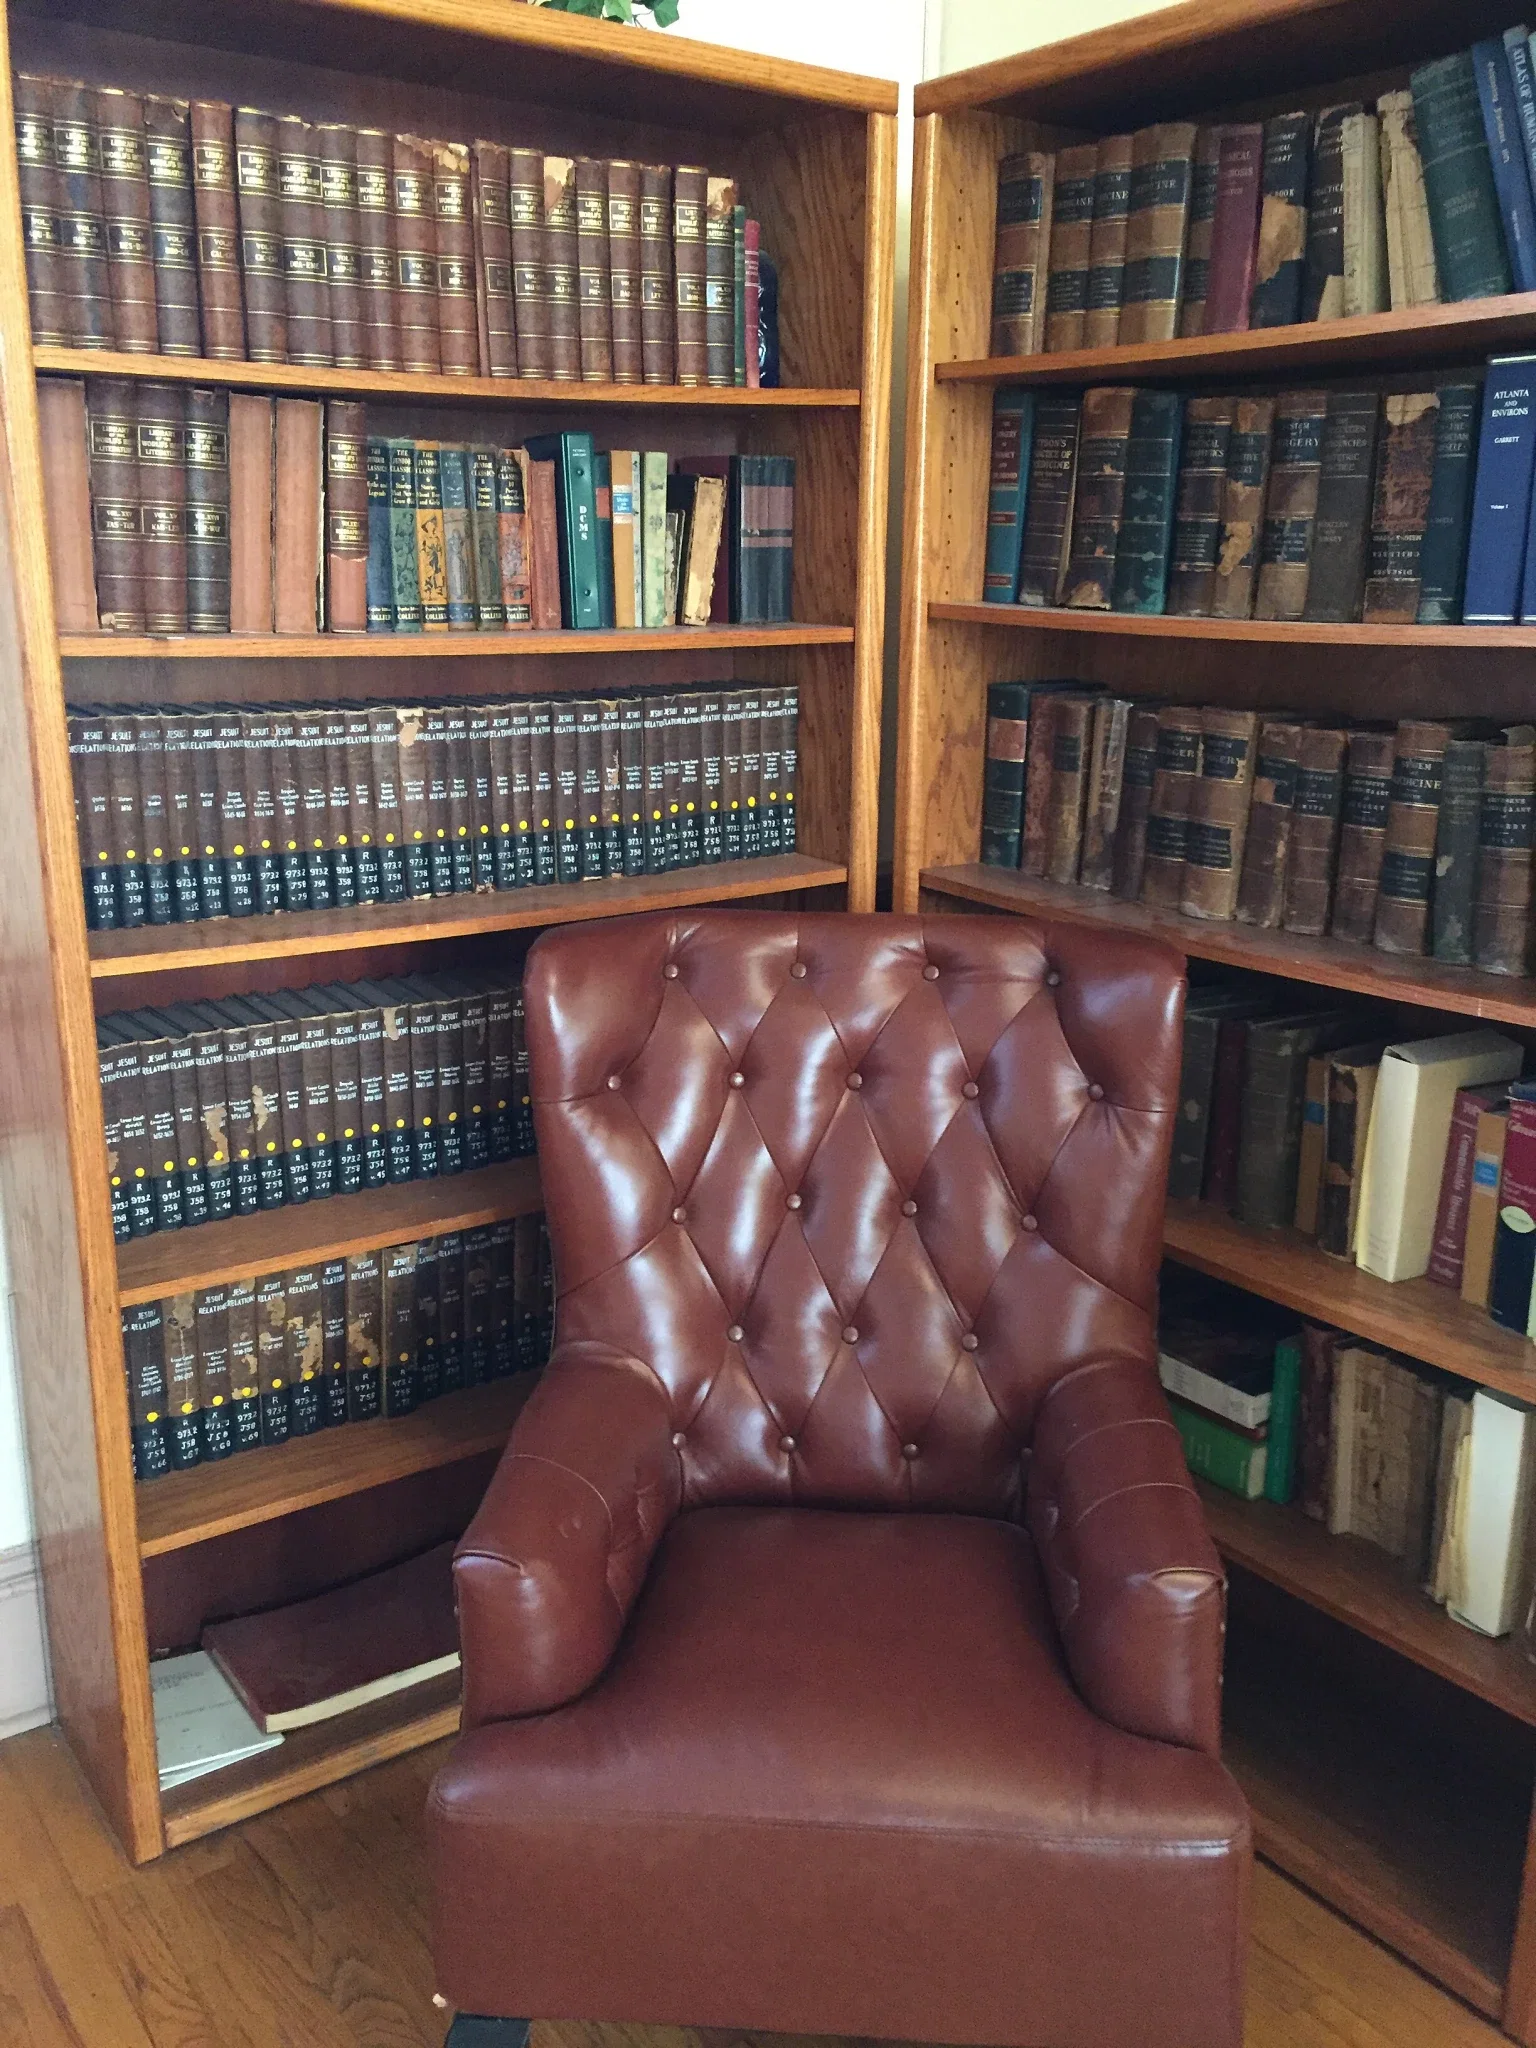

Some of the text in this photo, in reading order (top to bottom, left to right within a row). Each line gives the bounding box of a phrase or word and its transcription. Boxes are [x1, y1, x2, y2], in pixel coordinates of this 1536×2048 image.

[1493, 389, 1529, 399] ATLANTA
[1504, 400, 1518, 408] AND
[1491, 407, 1529, 417] ENVIRONS
[473, 461, 492, 469] JUNIOR
[579, 505, 589, 541] DCMS
[558, 714, 575, 723] JESUIT
[582, 714, 598, 722] JESUIT
[350, 724, 368, 733] JESUIT
[376, 723, 394, 732] JESUIT
[448, 721, 465, 729] JESUIT
[83, 731, 104, 740] JESUIT
[110, 731, 132, 740] JESUIT
[193, 729, 213, 738] JESUIT
[220, 728, 239, 737] JESUIT
[250, 727, 270, 736] JESUIT
[300, 727, 320, 735] JESUIT
[710, 815, 715, 824] R
[363, 851, 369, 860] R
[388, 850, 394, 858] R
[265, 859, 271, 868] R
[291, 857, 297, 865] R
[361, 875, 378, 884] J58
[416, 1014, 433, 1023] JESUIT
[441, 1012, 458, 1021] JESUIT
[336, 1025, 354, 1035] JESUIT
[361, 1021, 378, 1030] JESUIT
[306, 1029, 325, 1039] JESUIT
[254, 1037, 274, 1047] JESUIT
[201, 1044, 220, 1054] JESUIT
[228, 1042, 247, 1052] JESUIT
[172, 1047, 192, 1058] JESUIT
[148, 1052, 167, 1063] JESUIT
[347, 1144, 352, 1152] R
[243, 1163, 249, 1171] R
[268, 1159, 273, 1167] R
[137, 1183, 143, 1191] R
[357, 1260, 373, 1269] JESUIT
[393, 1257, 410, 1267] JESUIT
[326, 1264, 343, 1275] JESUIT
[351, 1267, 379, 1281] RELATIONS
[295, 1273, 312, 1283] JESUIT
[263, 1282, 281, 1291] JESUIT
[288, 1281, 319, 1295] RELATIONS
[272, 1396, 279, 1404] R
[243, 1402, 250, 1410] R
[240, 1422, 256, 1432] J58
